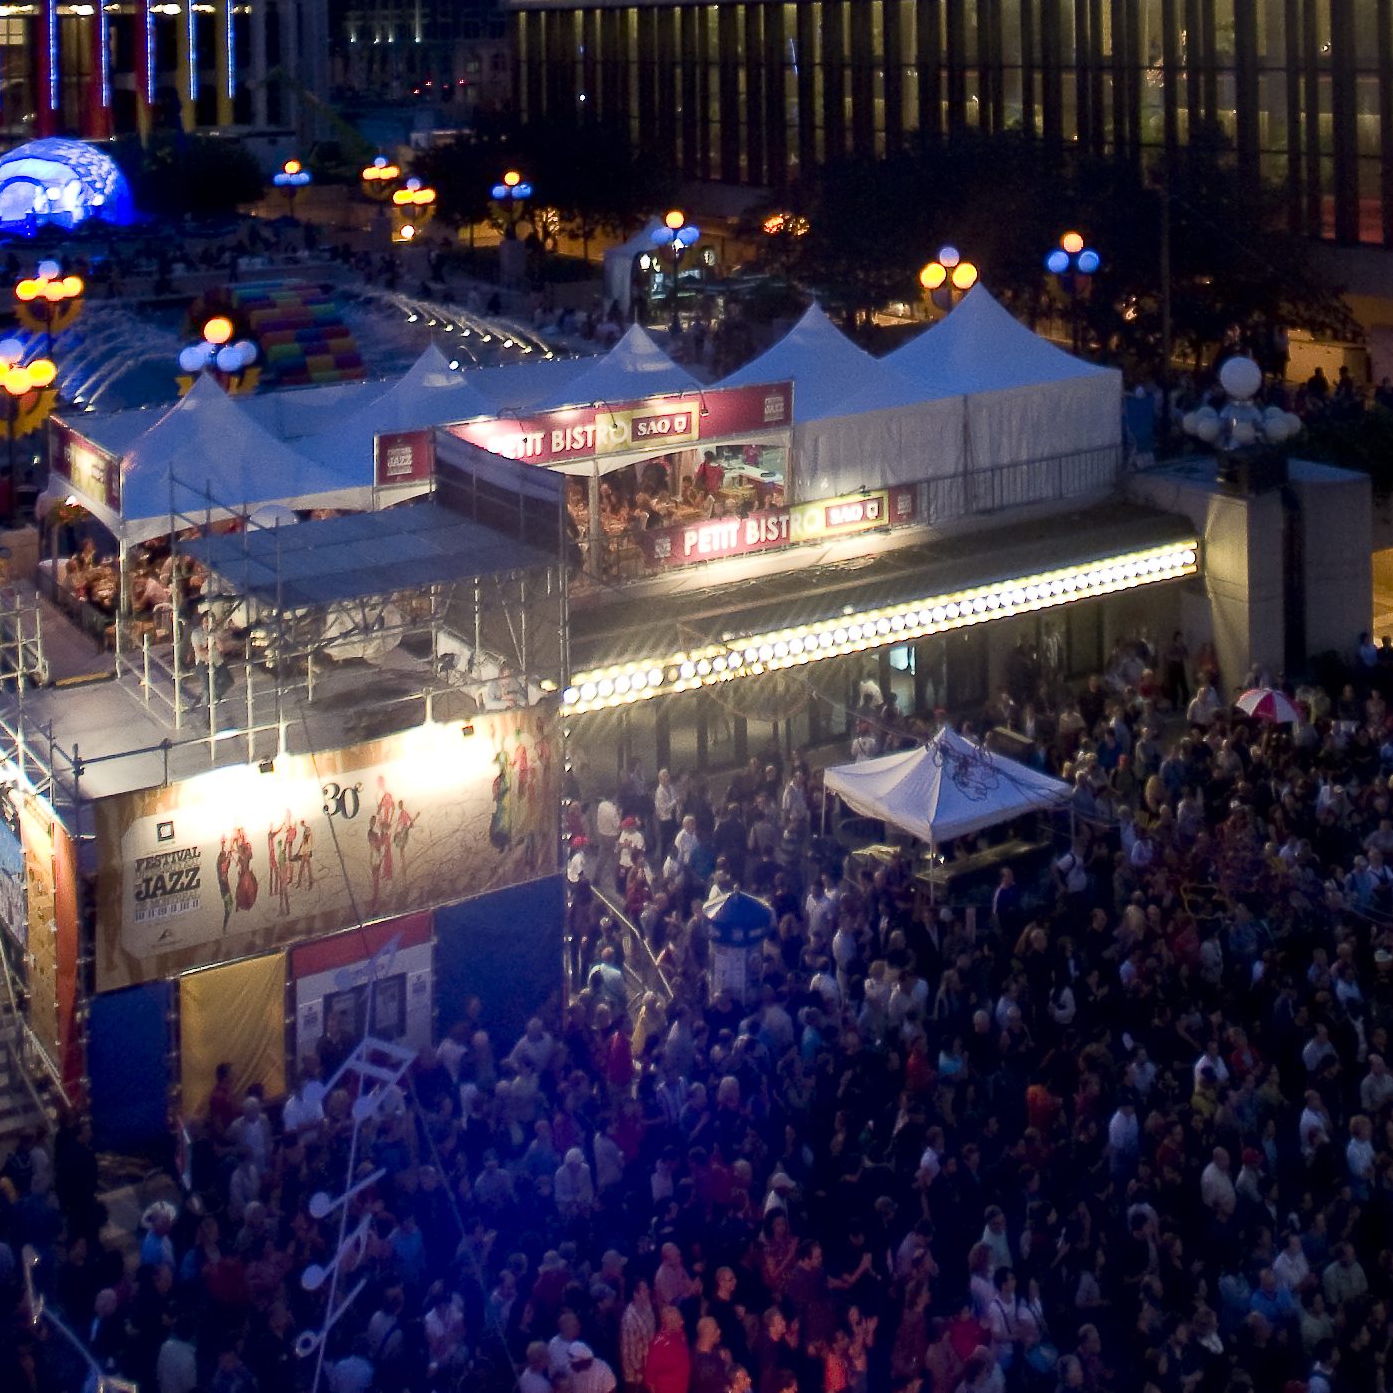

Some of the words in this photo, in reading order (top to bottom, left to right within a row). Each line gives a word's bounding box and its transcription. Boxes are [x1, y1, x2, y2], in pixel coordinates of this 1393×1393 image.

[551, 419, 630, 453] BISTRO
[637, 419, 671, 436] SAQ
[684, 520, 741, 556] PETIT
[746, 507, 824, 545] BISTRO
[135, 846, 201, 872] FESTIVAL
[135, 867, 201, 902] JAZZ
